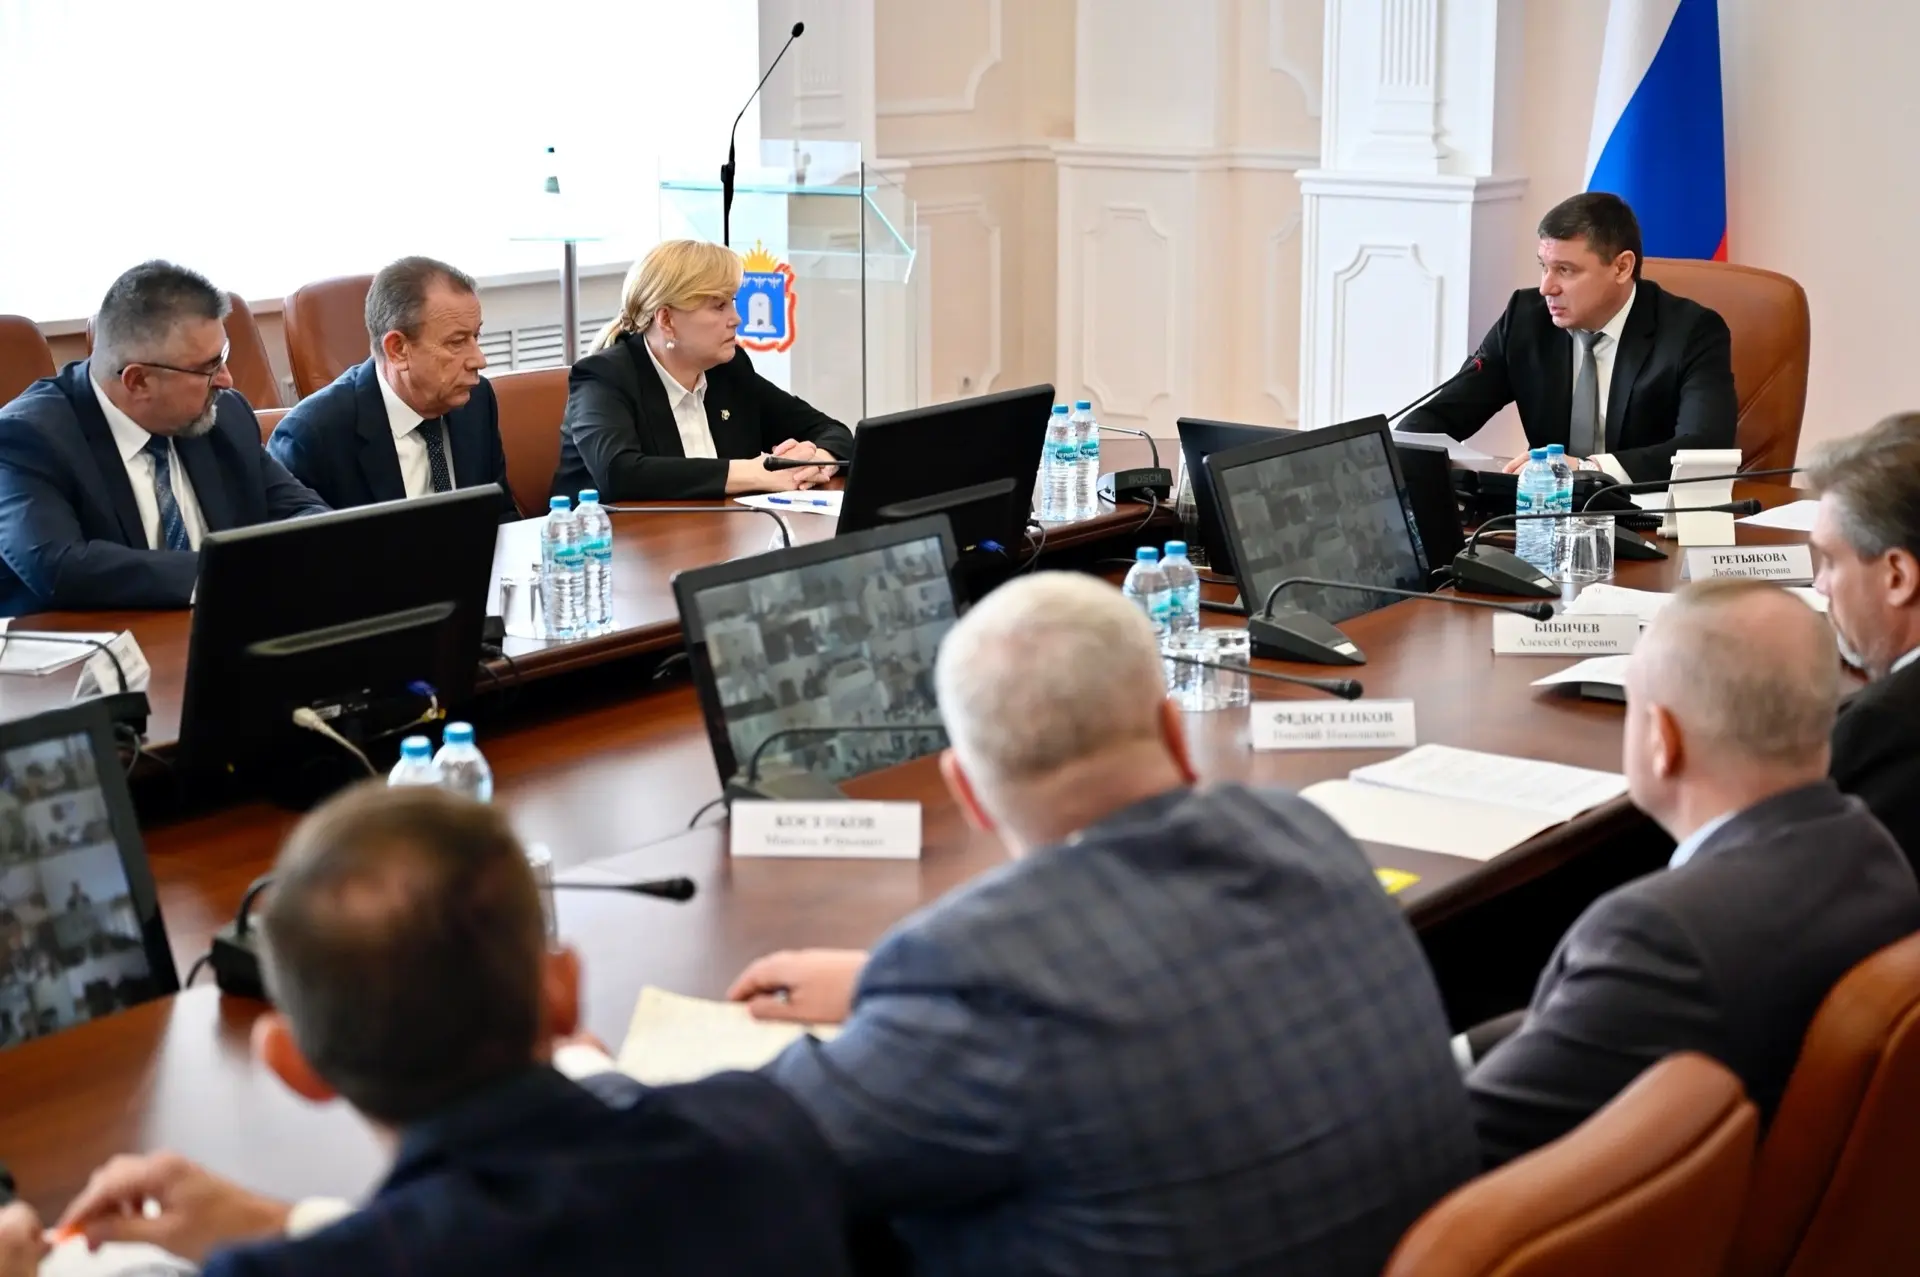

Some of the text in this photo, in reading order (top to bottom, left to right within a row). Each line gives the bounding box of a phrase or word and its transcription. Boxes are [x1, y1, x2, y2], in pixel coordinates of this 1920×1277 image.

[1128, 472, 1162, 484] BOSCH
[1711, 553, 1788, 564] ТРЕТЬЯКОВА
[1712, 566, 1791, 577] Любовь Петровна
[1535, 622, 1600, 633] БИБИЧЕВ
[1518, 637, 1618, 650] Алексей Сергеевич
